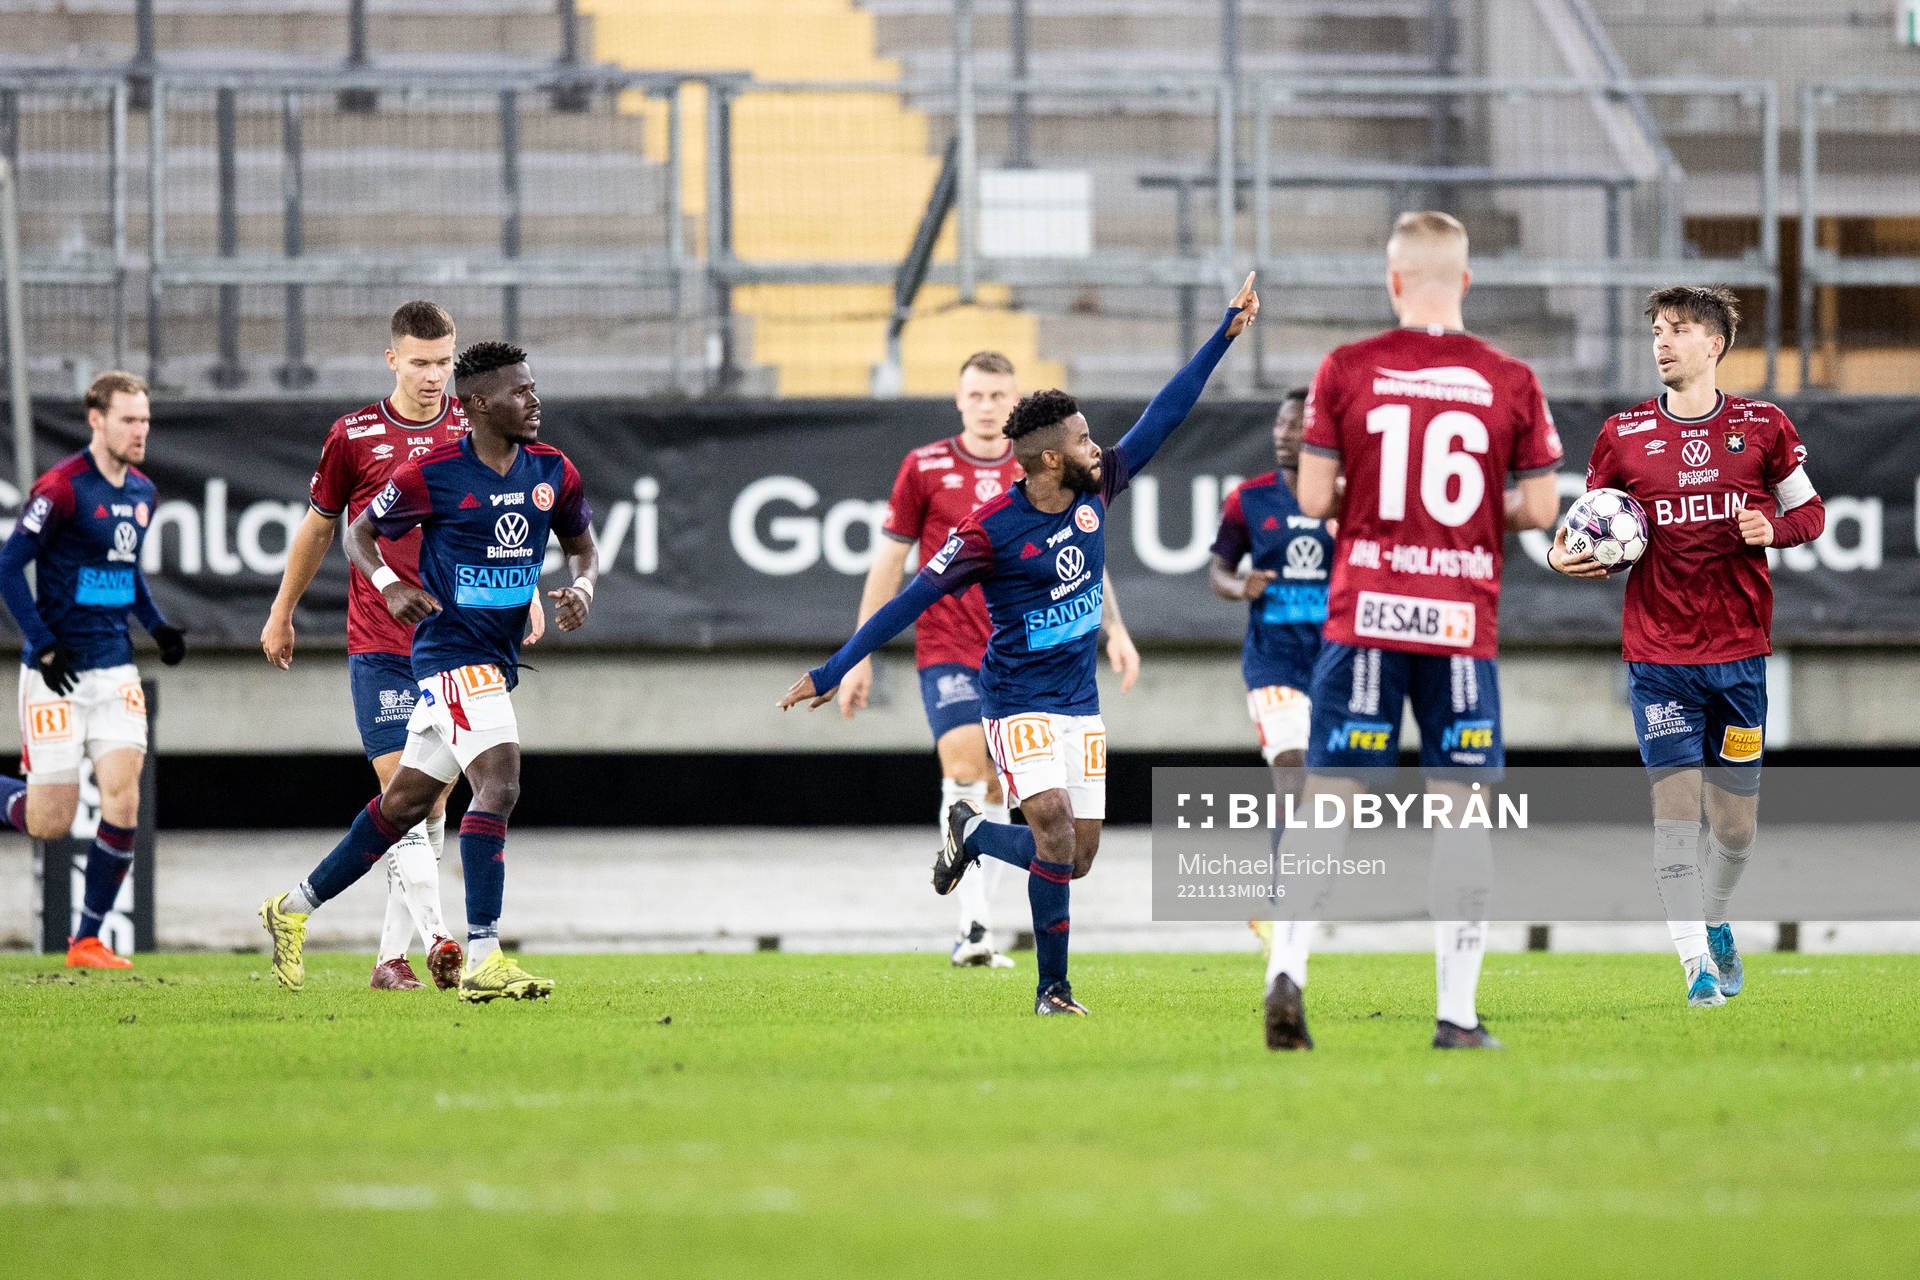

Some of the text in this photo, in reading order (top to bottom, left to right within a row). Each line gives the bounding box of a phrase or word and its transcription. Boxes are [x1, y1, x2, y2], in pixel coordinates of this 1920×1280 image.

[1681, 429, 1709, 438] BJELIN
[407, 437, 434, 446] BJELIN
[1366, 404, 1490, 527] 16
[1678, 468, 1719, 480] factoring
[1655, 492, 1748, 526] BJELIN
[487, 546, 533, 559] Bilmetro
[1362, 600, 1439, 636] BESAB
